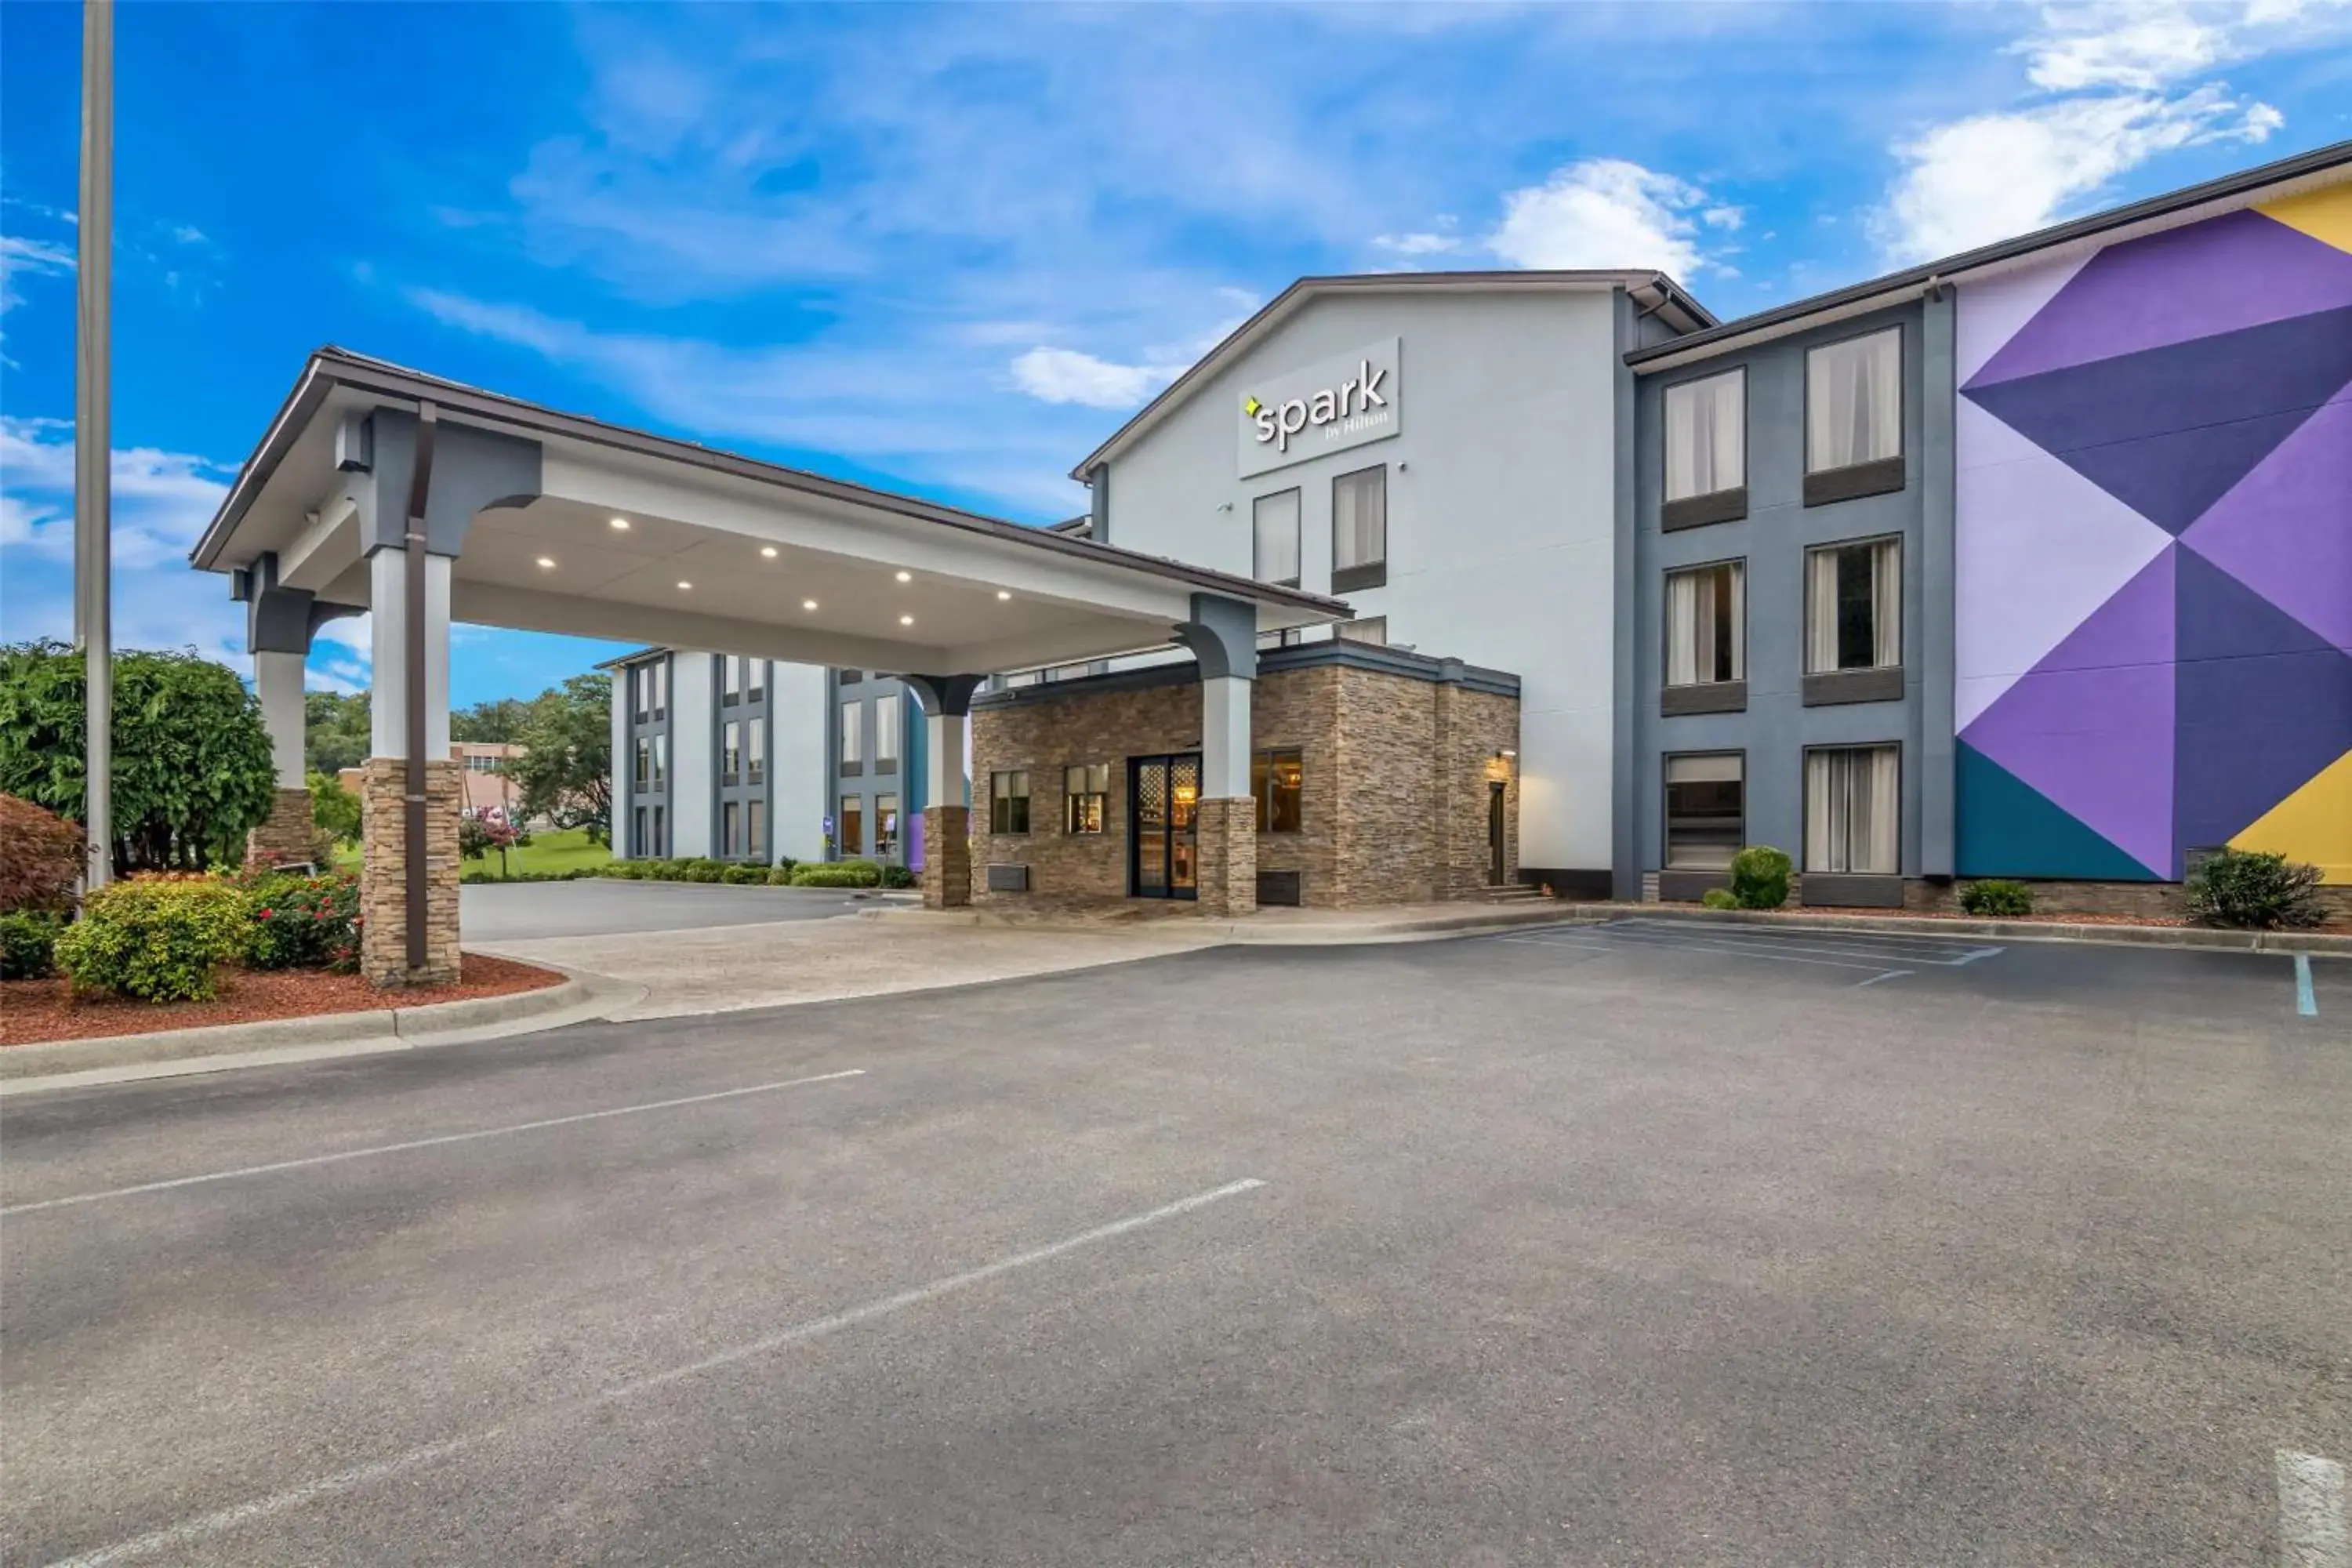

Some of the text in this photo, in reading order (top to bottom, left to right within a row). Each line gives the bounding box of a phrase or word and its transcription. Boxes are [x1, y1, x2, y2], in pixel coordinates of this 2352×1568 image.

[1254, 358, 1387, 452] spark
[1325, 412, 1388, 441] by Hilton
